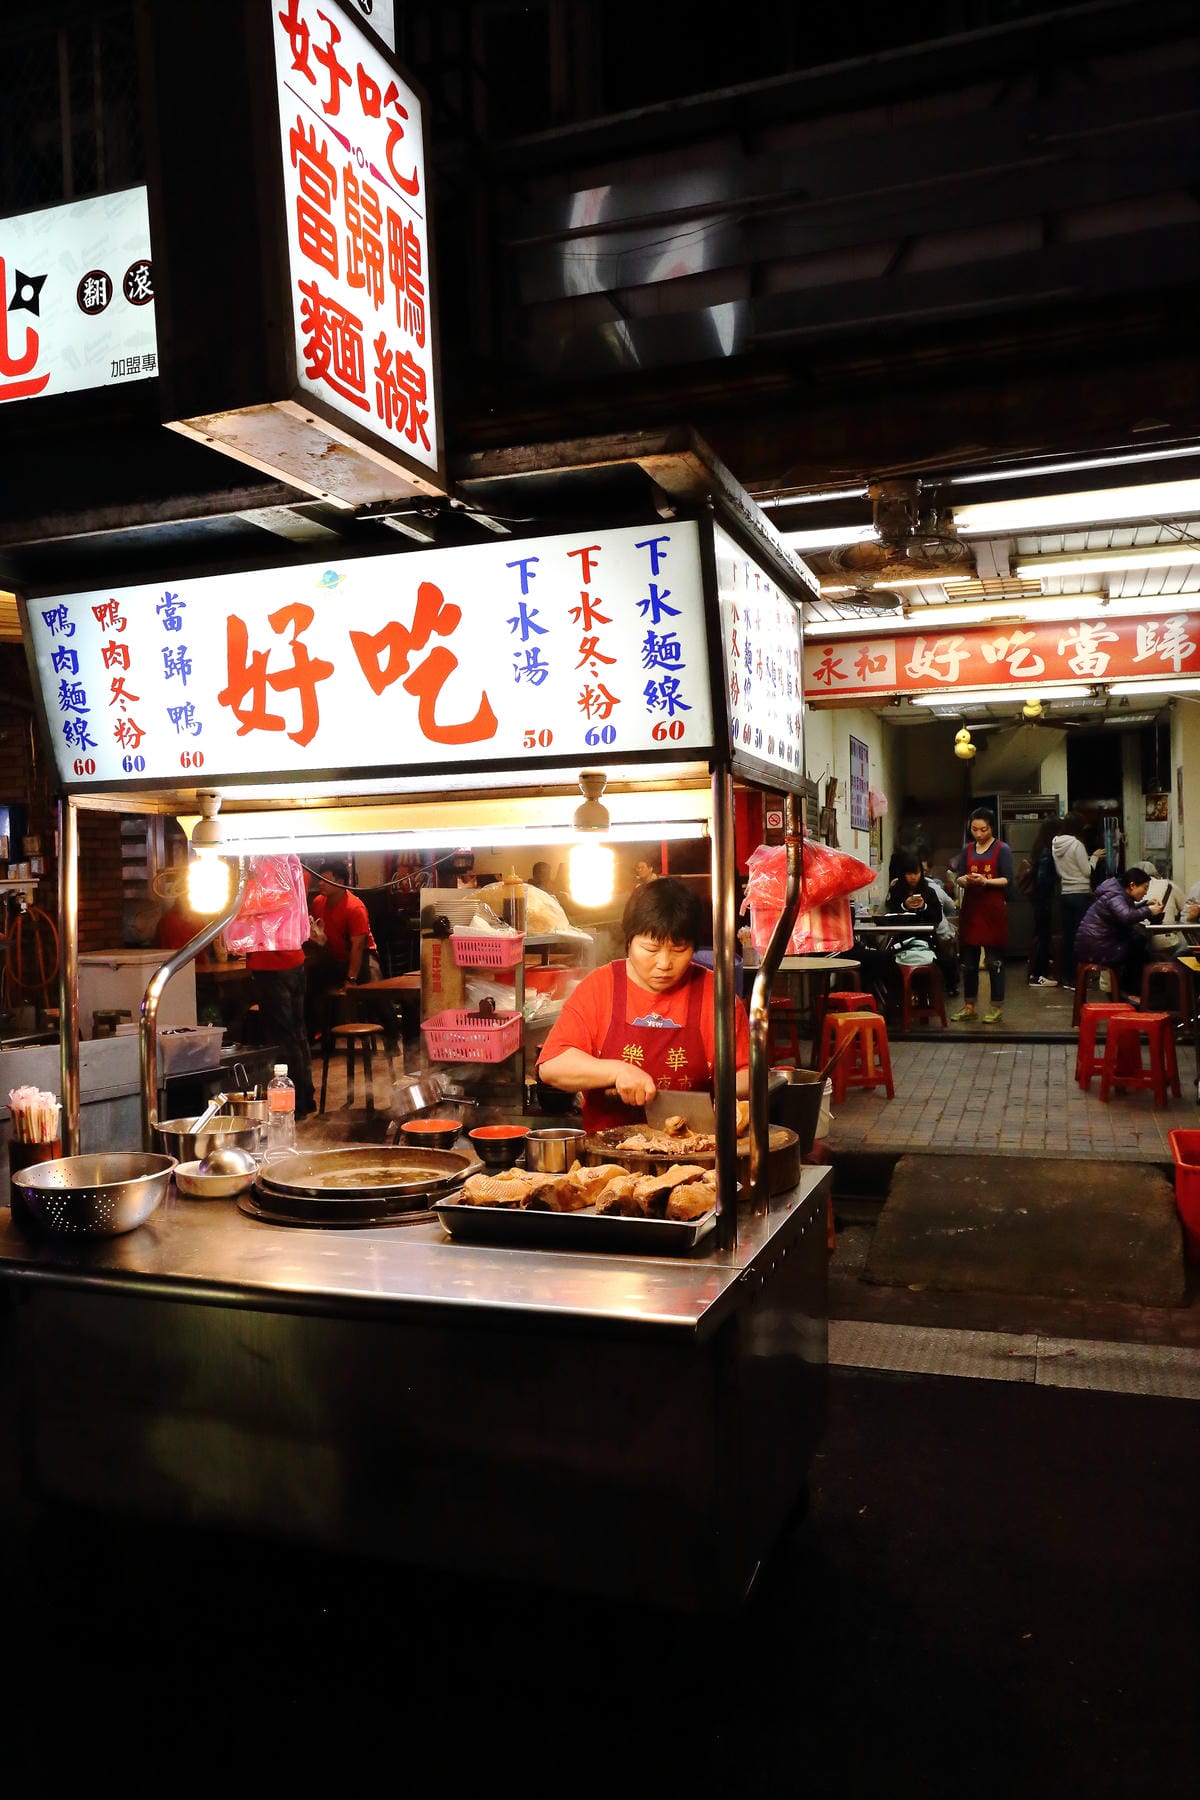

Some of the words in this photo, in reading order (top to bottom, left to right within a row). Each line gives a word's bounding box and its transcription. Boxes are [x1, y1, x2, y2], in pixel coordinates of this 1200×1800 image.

[278, 0, 419, 197] 好吃
[289, 114, 426, 349] 當歸鴨
[111, 353, 157, 378] 加盟專
[298, 279, 431, 452] 麵線
[41, 604, 99, 752] 鴨肉麵線
[91, 598, 146, 750] 鴨肉冬粉
[155, 591, 203, 737] 當歸鴨
[217, 581, 499, 747] 好吃
[505, 556, 550, 687] 下水湯
[566, 545, 622, 720] 下水冬粉
[635, 535, 693, 717] 下水麵線
[812, 646, 888, 686] 永和
[904, 613, 1198, 683] 好吃當歸
[73, 758, 96, 775] 60
[122, 755, 146, 772] 60
[180, 751, 205, 768] 60
[523, 729, 553, 748] 50
[585, 725, 617, 746] 60
[652, 720, 686, 741] 60
[621, 1043, 689, 1072] 樂華
